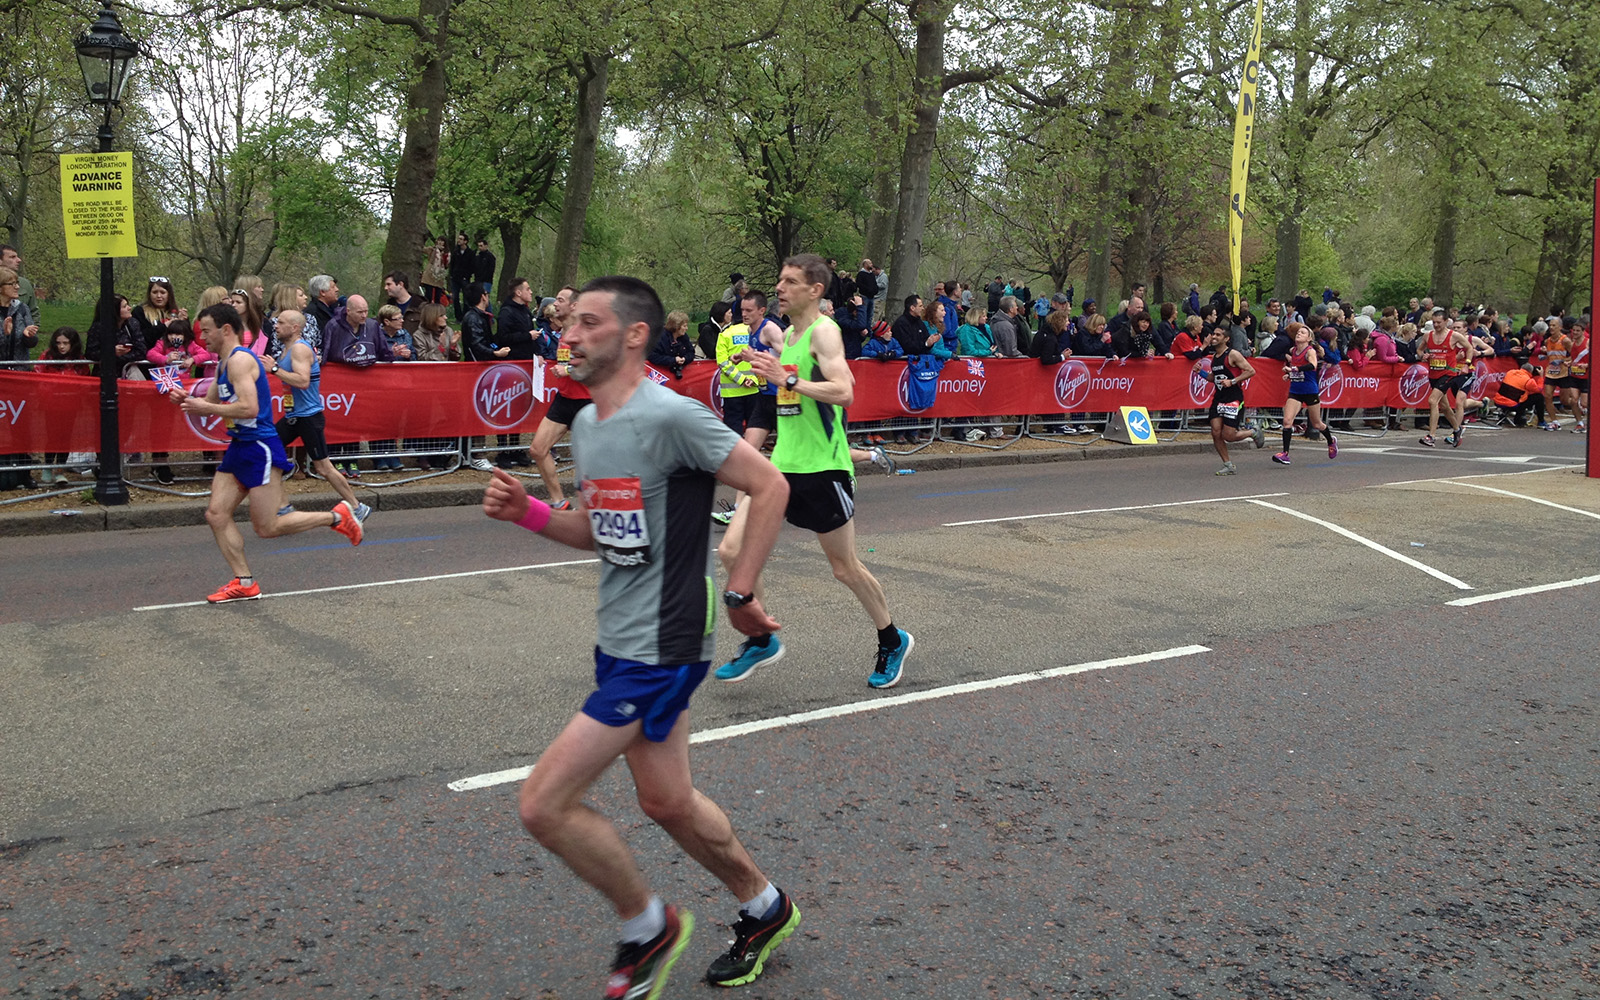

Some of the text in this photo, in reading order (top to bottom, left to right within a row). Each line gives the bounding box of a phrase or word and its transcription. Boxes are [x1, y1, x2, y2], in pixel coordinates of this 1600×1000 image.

[72, 172, 122, 182] ADVANCE
[72, 182, 122, 192] WARNING
[939, 379, 986, 397] money
[1058, 366, 1134, 400] Virgin money
[1318, 373, 1340, 398] irgin
[1344, 377, 1380, 392] money
[480, 372, 530, 418] Virgin
